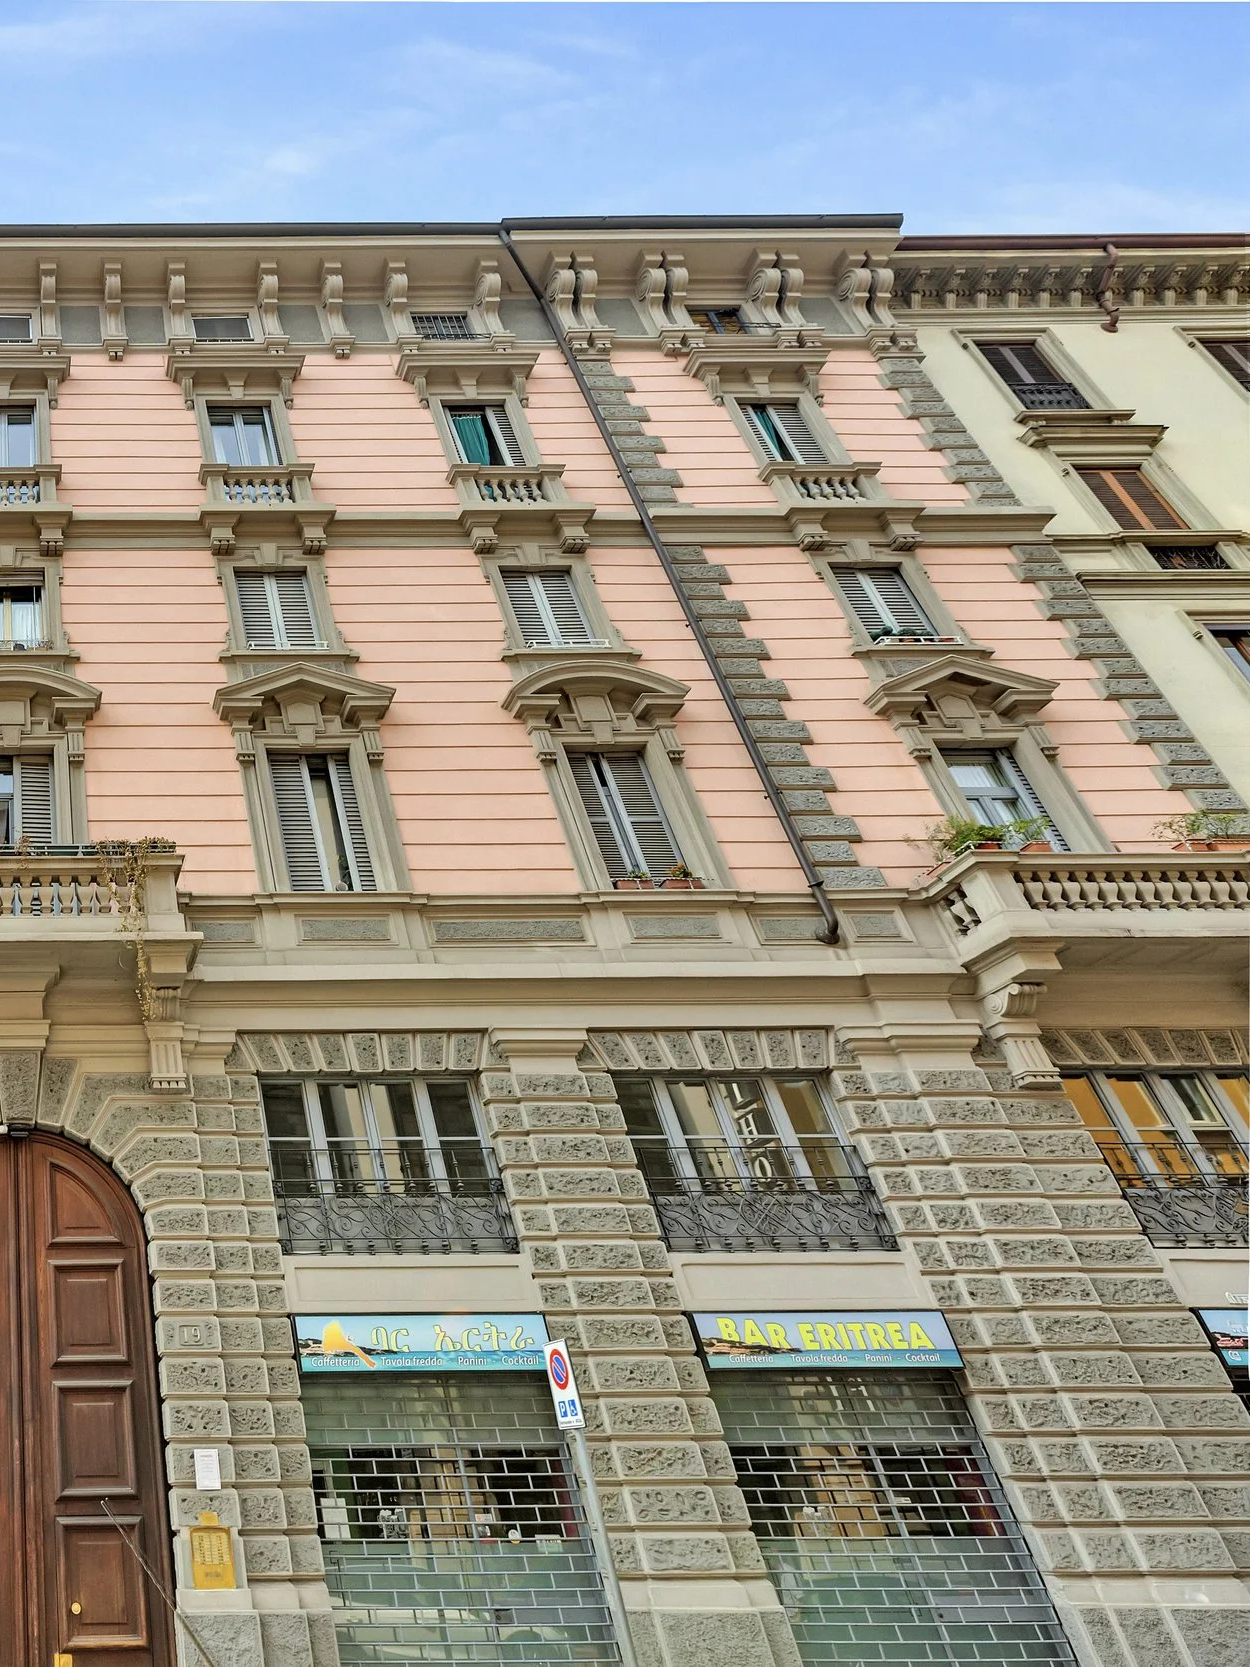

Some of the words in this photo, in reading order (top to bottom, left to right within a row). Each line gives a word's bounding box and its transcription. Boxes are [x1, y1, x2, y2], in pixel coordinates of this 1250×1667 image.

[183, 1327, 201, 1344] 19
[371, 1326, 410, 1352] ባር
[716, 1317, 793, 1349] BAR
[797, 1321, 937, 1350] ERITREA
[311, 1356, 360, 1367] Caffetteria
[381, 1356, 411, 1366] Tavola
[412, 1356, 443, 1366] fredda
[457, 1356, 487, 1366] Panini
[501, 1355, 539, 1366] Cocktail
[729, 1354, 774, 1363] Caffetteria
[791, 1354, 819, 1363] Tavola
[820, 1353, 848, 1363] fredda
[865, 1353, 892, 1362] Panini
[905, 1353, 941, 1362] Cocktail
